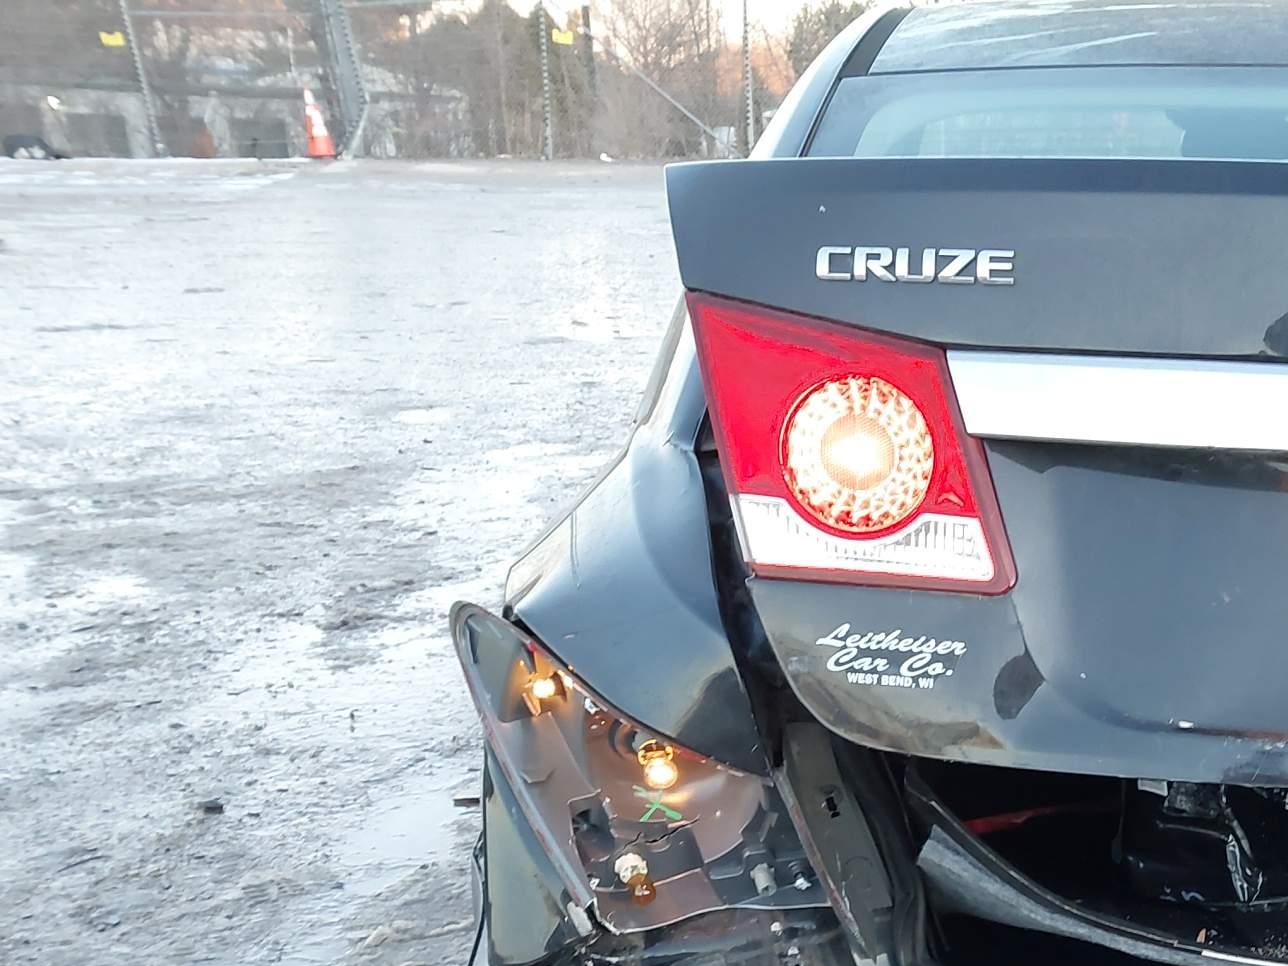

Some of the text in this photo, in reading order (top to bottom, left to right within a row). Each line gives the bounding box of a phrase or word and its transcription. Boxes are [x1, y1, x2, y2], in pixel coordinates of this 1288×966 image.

[815, 246, 1015, 285] CRUZE
[815, 622, 968, 656] Leitheiser
[826, 647, 954, 677] Car Co.
[846, 671, 935, 689] WEST BEND, WI
